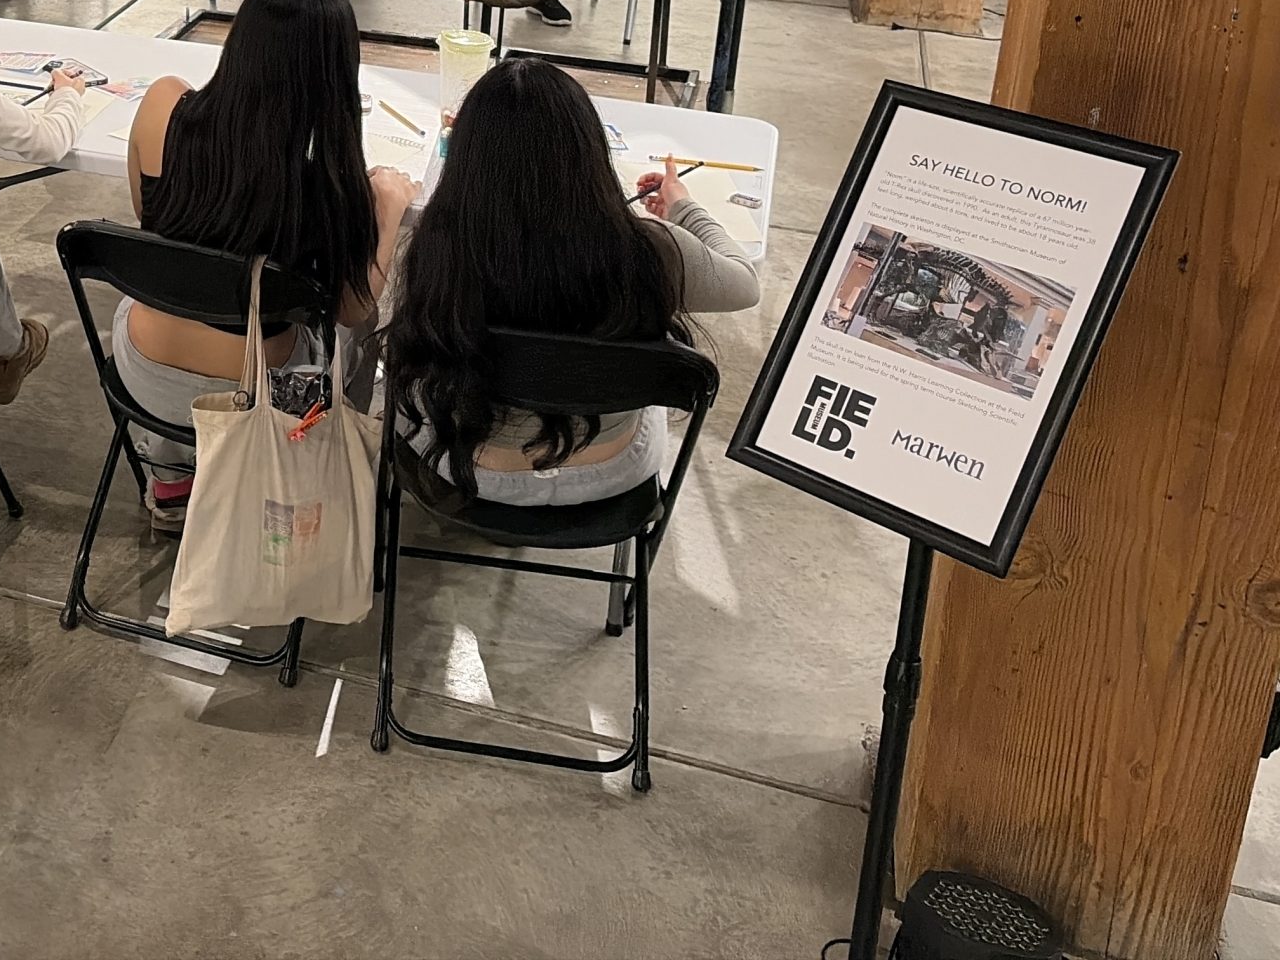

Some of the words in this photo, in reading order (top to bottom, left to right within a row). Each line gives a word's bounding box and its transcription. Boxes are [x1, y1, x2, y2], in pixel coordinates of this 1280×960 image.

[909, 154, 942, 172] SAY
[942, 164, 995, 186] HELLO
[1000, 178, 1023, 194] TO
[1026, 187, 1088, 213] NORM!
[811, 402, 827, 430] MUSEUM
